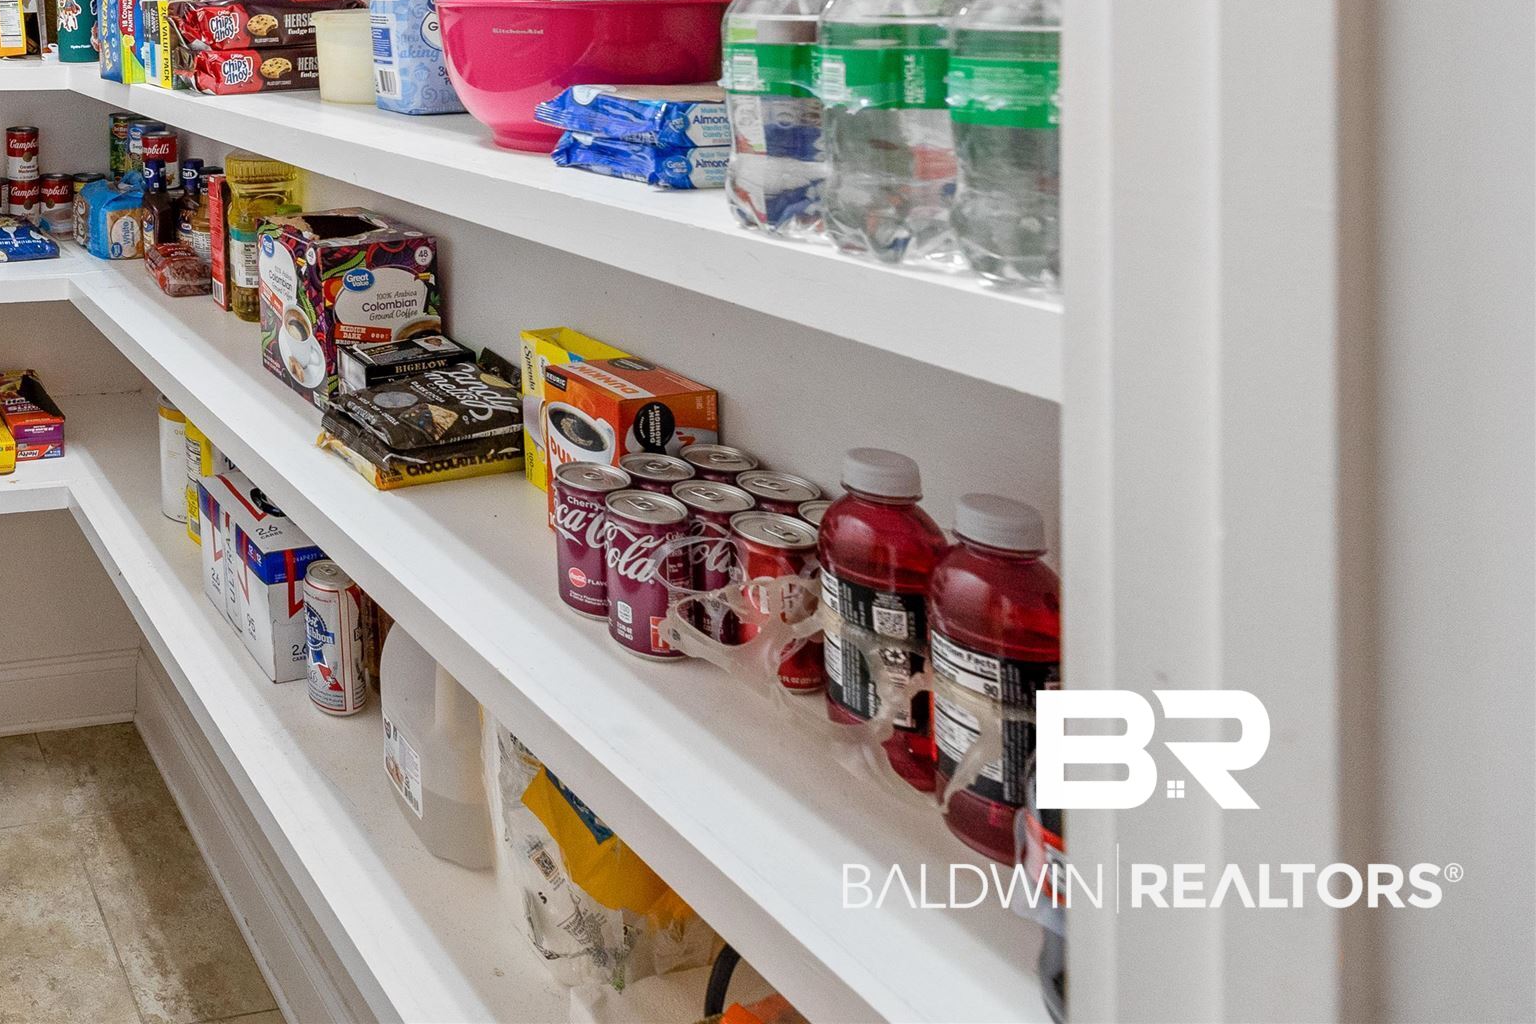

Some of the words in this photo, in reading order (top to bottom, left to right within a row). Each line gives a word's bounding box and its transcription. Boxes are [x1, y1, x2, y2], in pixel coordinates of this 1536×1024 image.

[210, 15, 233, 33] Chips
[285, 13, 315, 27] HERSH
[214, 13, 240, 43] Ahoy!
[222, 60, 247, 76] Chips
[225, 57, 254, 85] Ahoy!
[904, 54, 915, 104] RECYCLE
[9, 138, 39, 149] Campb
[142, 143, 170, 157] mpbell's
[10, 185, 39, 197] Campbe
[41, 185, 69, 196] ampbell's
[418, 250, 428, 258] 48
[346, 273, 369, 282] Great
[352, 279, 370, 287] Value
[376, 292, 392, 300] 100%
[393, 289, 417, 298] Arabica
[362, 298, 418, 312] Colombian
[369, 311, 394, 321] Ground
[396, 308, 418, 319] Coffee
[395, 359, 448, 374] BIGELOW
[524, 346, 536, 391] Splenda
[546, 372, 566, 387] KEURIG
[18, 450, 38, 458] Hefty
[406, 455, 475, 476] CHOCOLATE
[567, 496, 599, 510] cherry
[256, 525, 278, 537] 2.6
[967, 651, 998, 670] Facts
